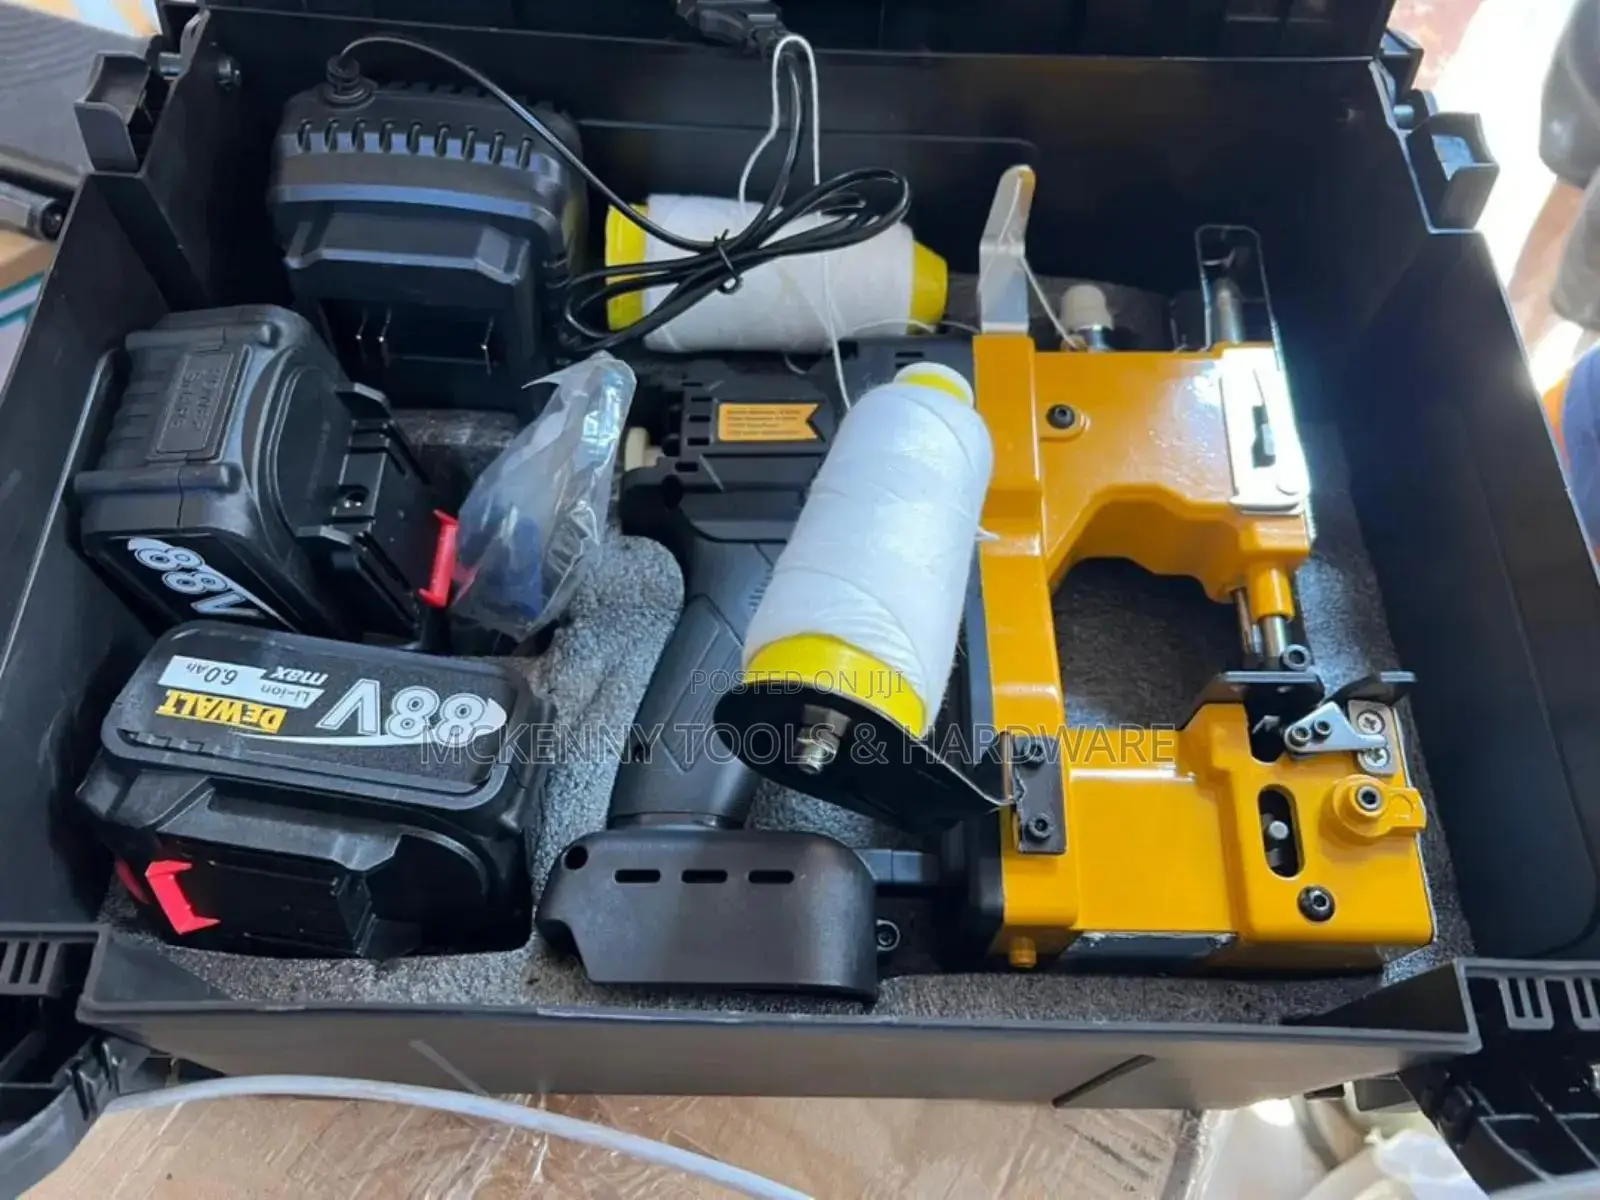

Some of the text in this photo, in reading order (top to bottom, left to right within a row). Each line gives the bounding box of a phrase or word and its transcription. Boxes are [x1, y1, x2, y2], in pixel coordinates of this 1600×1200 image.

[134, 546, 262, 618] 88V
[260, 684, 311, 703] Li-ion
[269, 665, 329, 687] max
[315, 677, 487, 748] 88V
